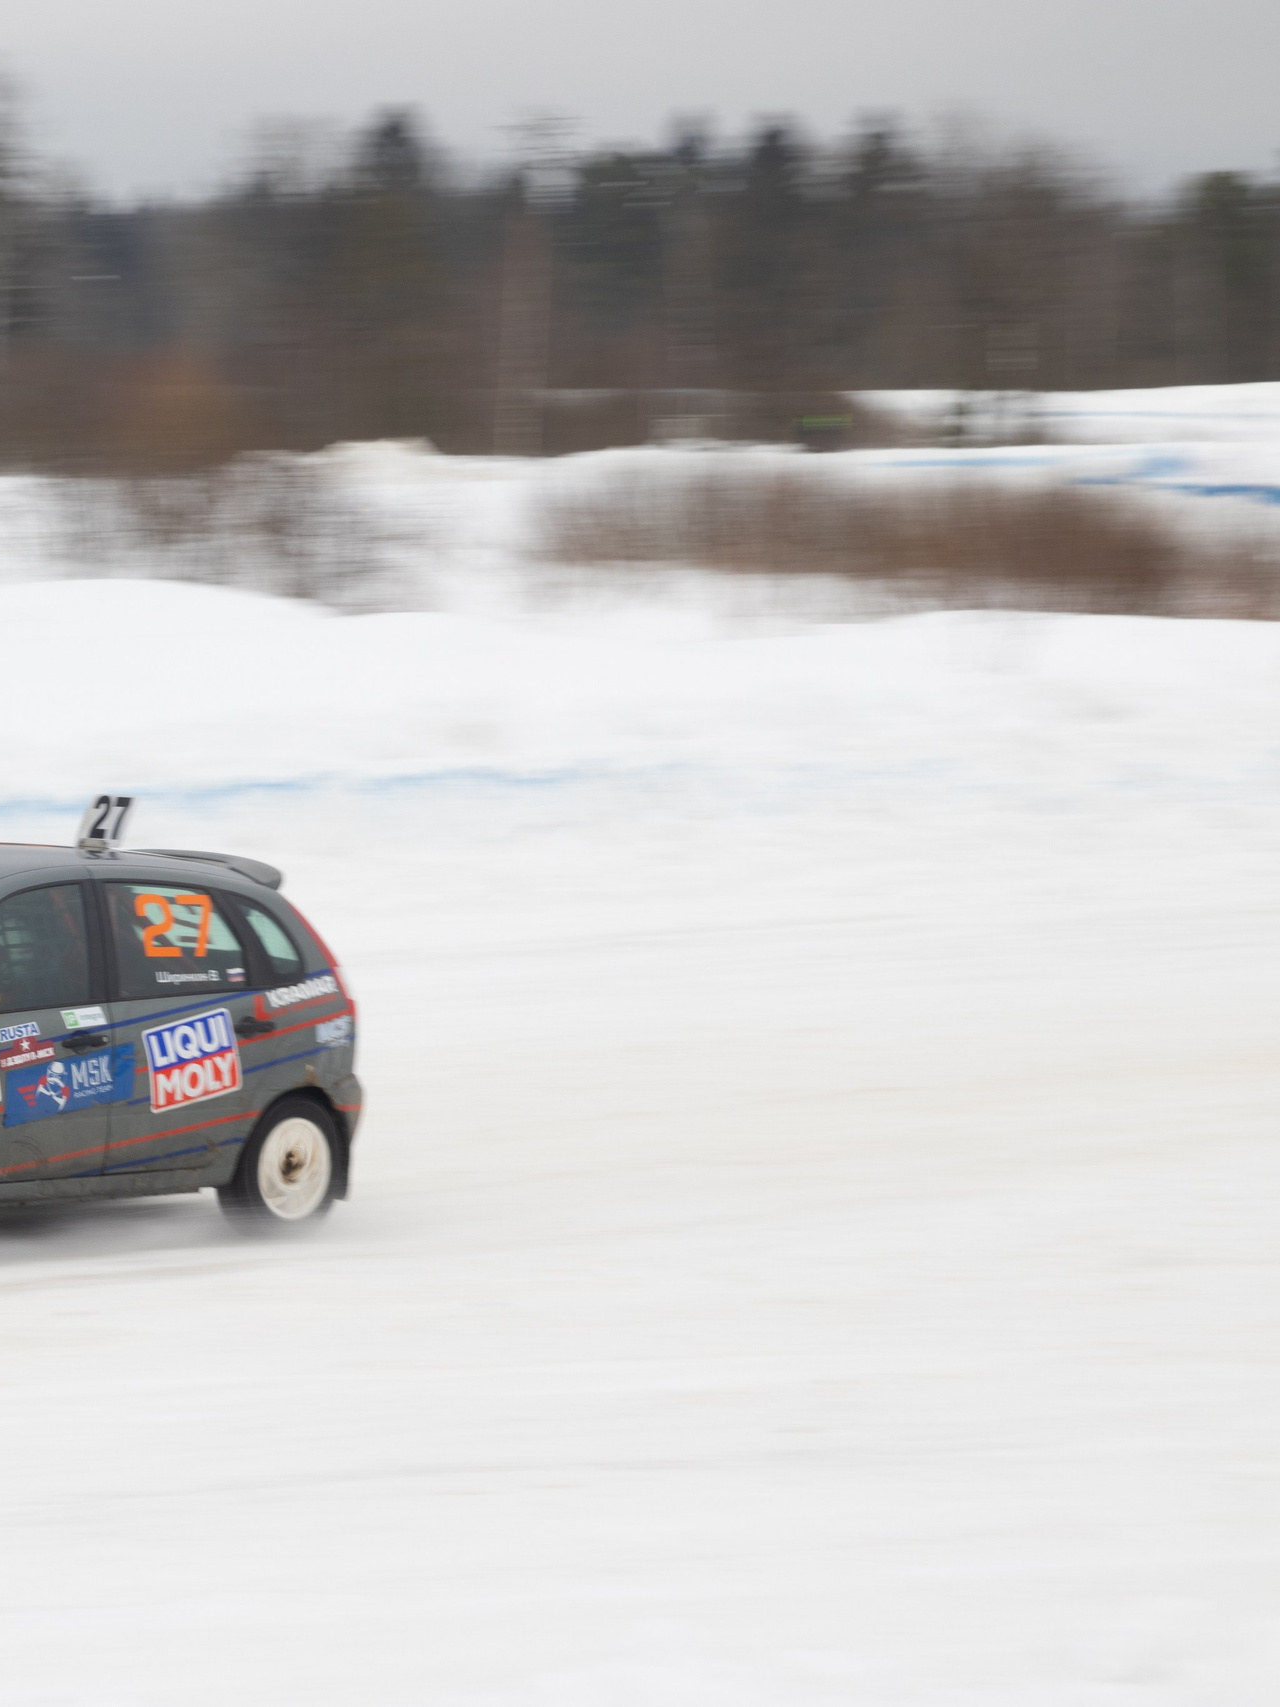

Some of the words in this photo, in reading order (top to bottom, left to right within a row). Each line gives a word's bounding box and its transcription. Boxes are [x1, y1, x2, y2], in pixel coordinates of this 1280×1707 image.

[88, 795, 134, 840] 27
[134, 893, 213, 957] 27
[265, 975, 339, 1008] KRAMAR
[0, 1023, 39, 1041] RUSTA
[148, 1014, 231, 1067] LIQUI
[71, 1055, 113, 1090] MSK
[156, 1052, 235, 1106] MOLY
